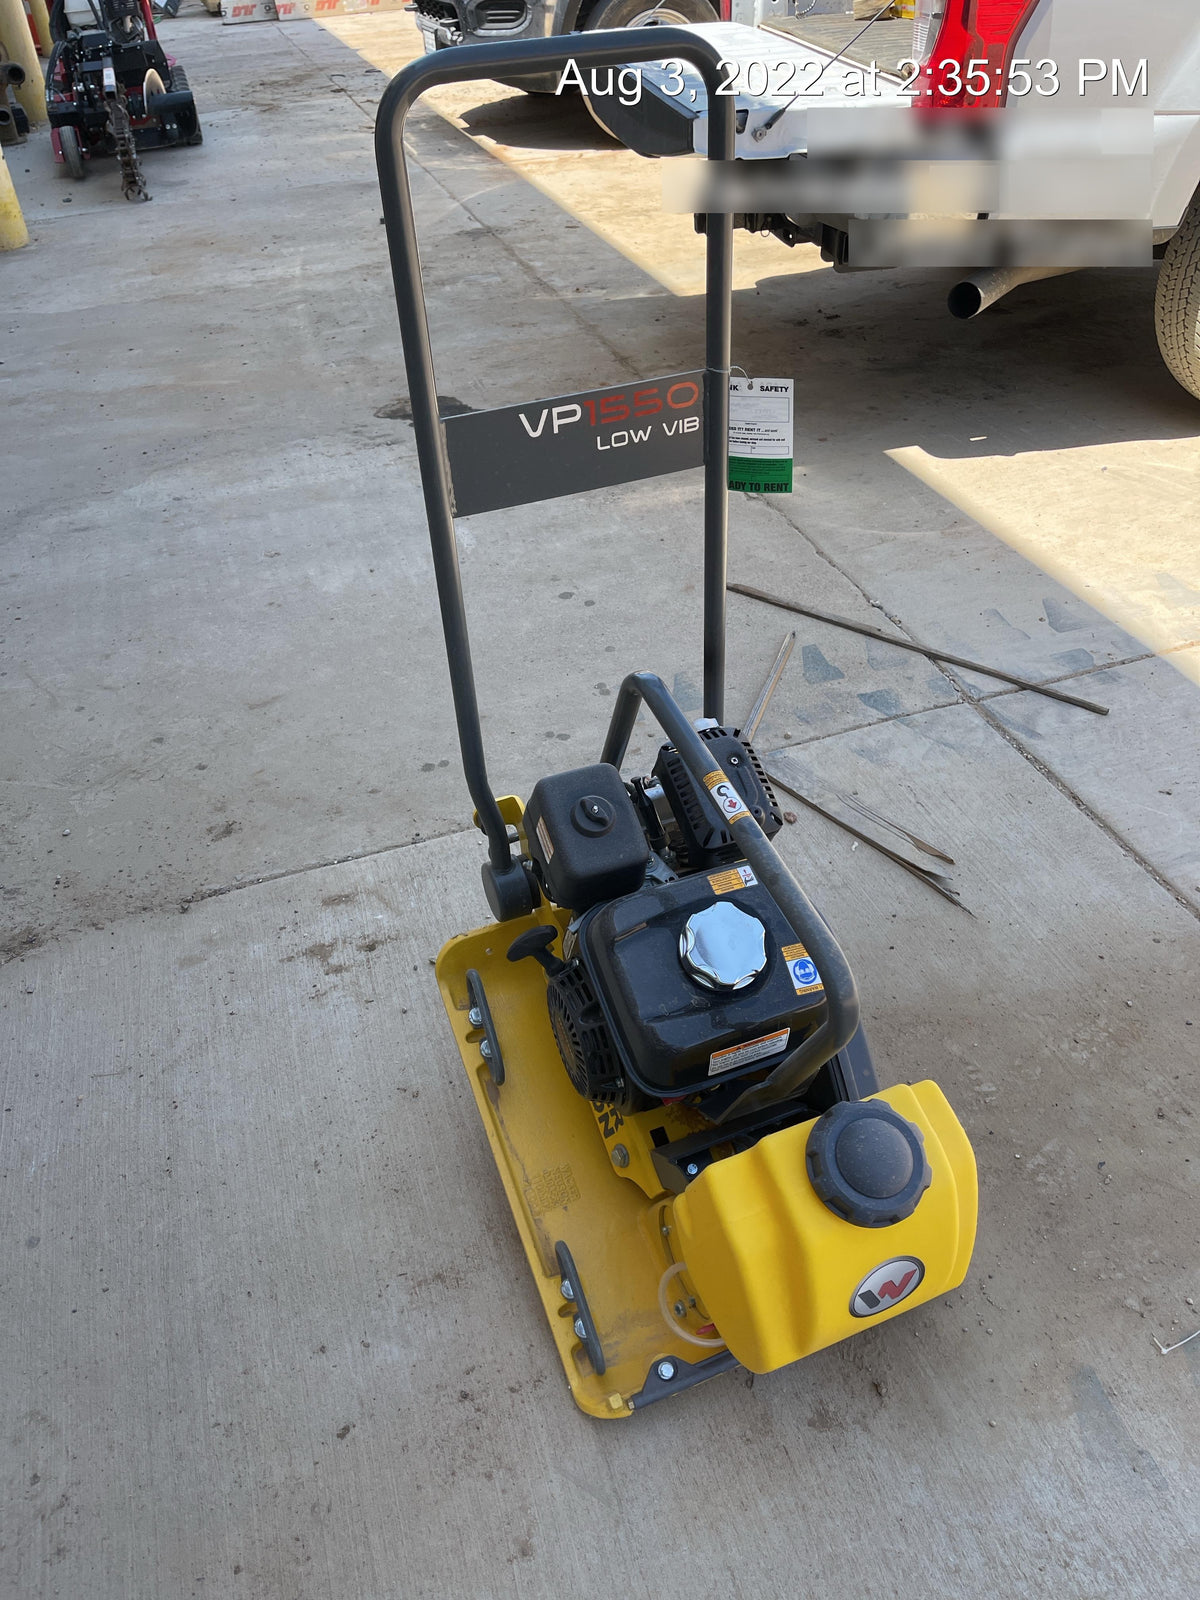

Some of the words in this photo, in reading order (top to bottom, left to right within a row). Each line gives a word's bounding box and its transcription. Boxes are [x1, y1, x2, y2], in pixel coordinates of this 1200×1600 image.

[759, 385, 789, 393] SAFETY
[518, 381, 700, 438] VP1550
[596, 425, 652, 451] LOW
[662, 416, 700, 436] VIB
[728, 480, 747, 491] ADY
[749, 482, 761, 492] TO
[763, 482, 789, 492] RENT
